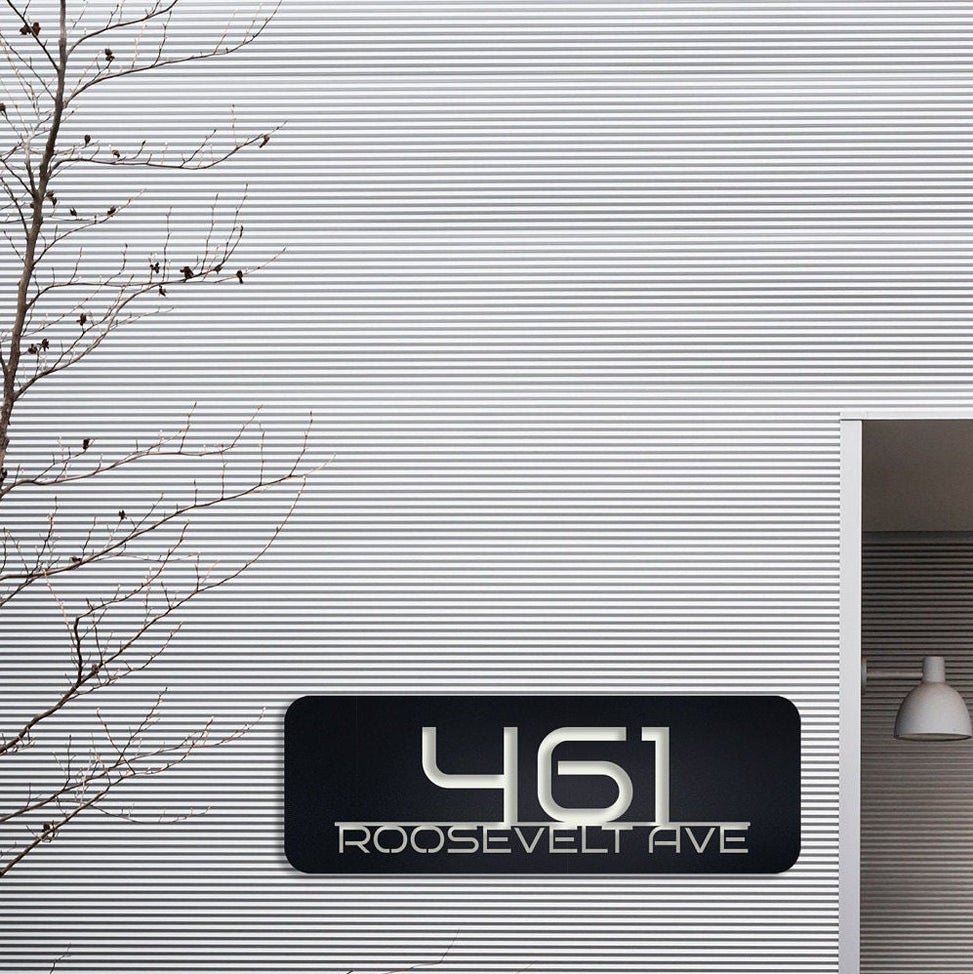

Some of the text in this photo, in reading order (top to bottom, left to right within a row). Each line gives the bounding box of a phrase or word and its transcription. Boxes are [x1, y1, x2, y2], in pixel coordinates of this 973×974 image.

[421, 726, 670, 825] 461
[337, 824, 750, 854] ROOSEVELT AVE
